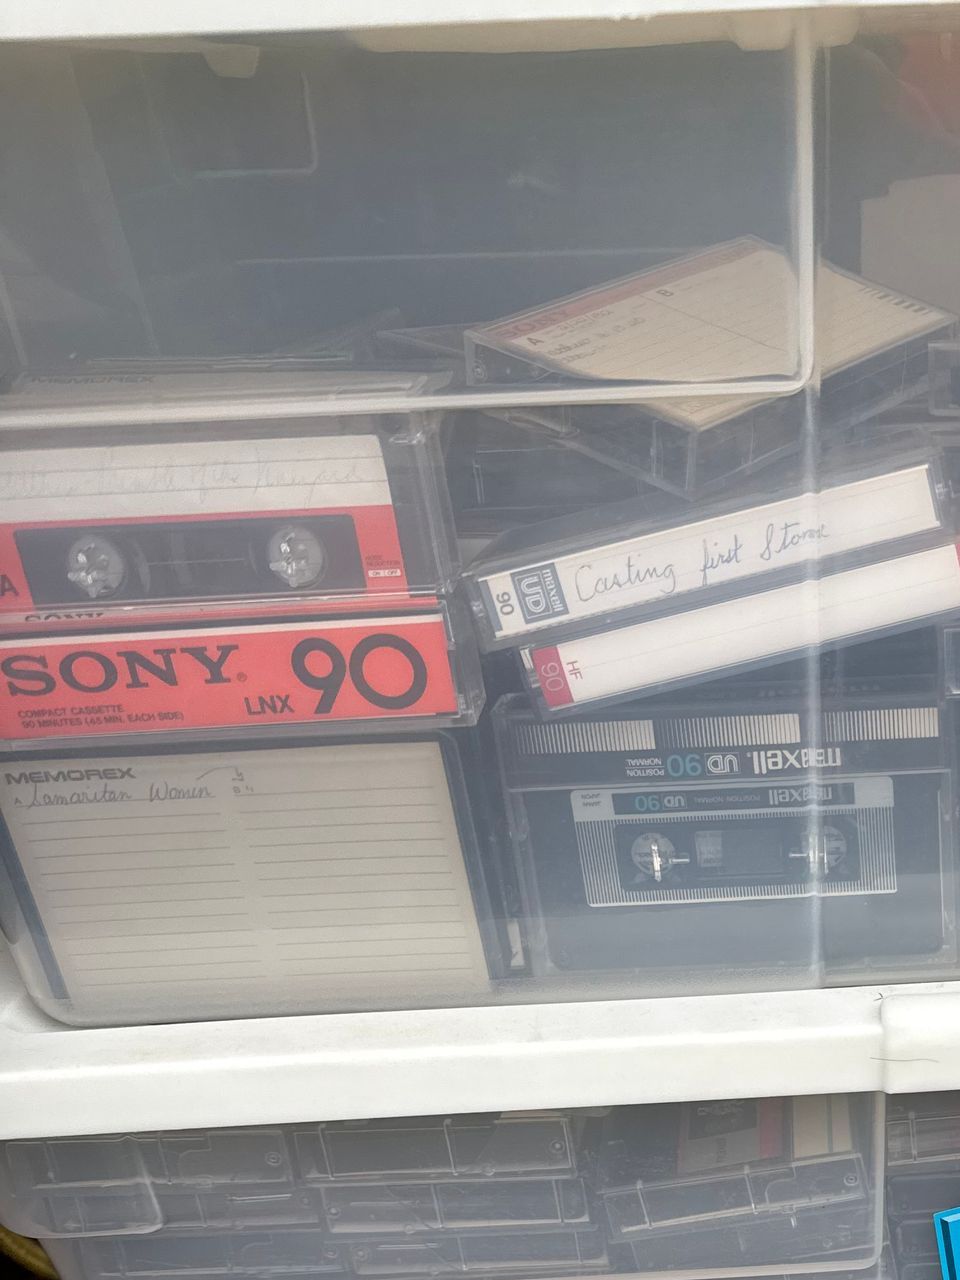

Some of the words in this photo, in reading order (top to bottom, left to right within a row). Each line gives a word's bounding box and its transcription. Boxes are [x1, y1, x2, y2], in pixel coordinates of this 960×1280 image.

[574, 554, 676, 601] Casting
[699, 534, 742, 586] first
[541, 569, 565, 612] maxell
[496, 592, 515, 616] 90
[0, 644, 240, 697] SONY
[244, 693, 295, 716] LNX
[290, 633, 428, 715] 90
[541, 662, 564, 691] 90
[566, 660, 583, 680] HF
[18, 705, 66, 718] COMPACT
[71, 704, 125, 716] CASSETTE
[38, 718, 83, 729] MINUTES
[626, 757, 662, 767] NORMAL
[666, 753, 701, 777] 90
[706, 753, 740, 775] UD
[752, 747, 842, 775] maxell
[5, 767, 136, 785] MEMOREX
[627, 768, 665, 777] POSITION
[634, 794, 660, 811] 90
[664, 795, 685, 808] UD
[768, 783, 832, 806] maxell
